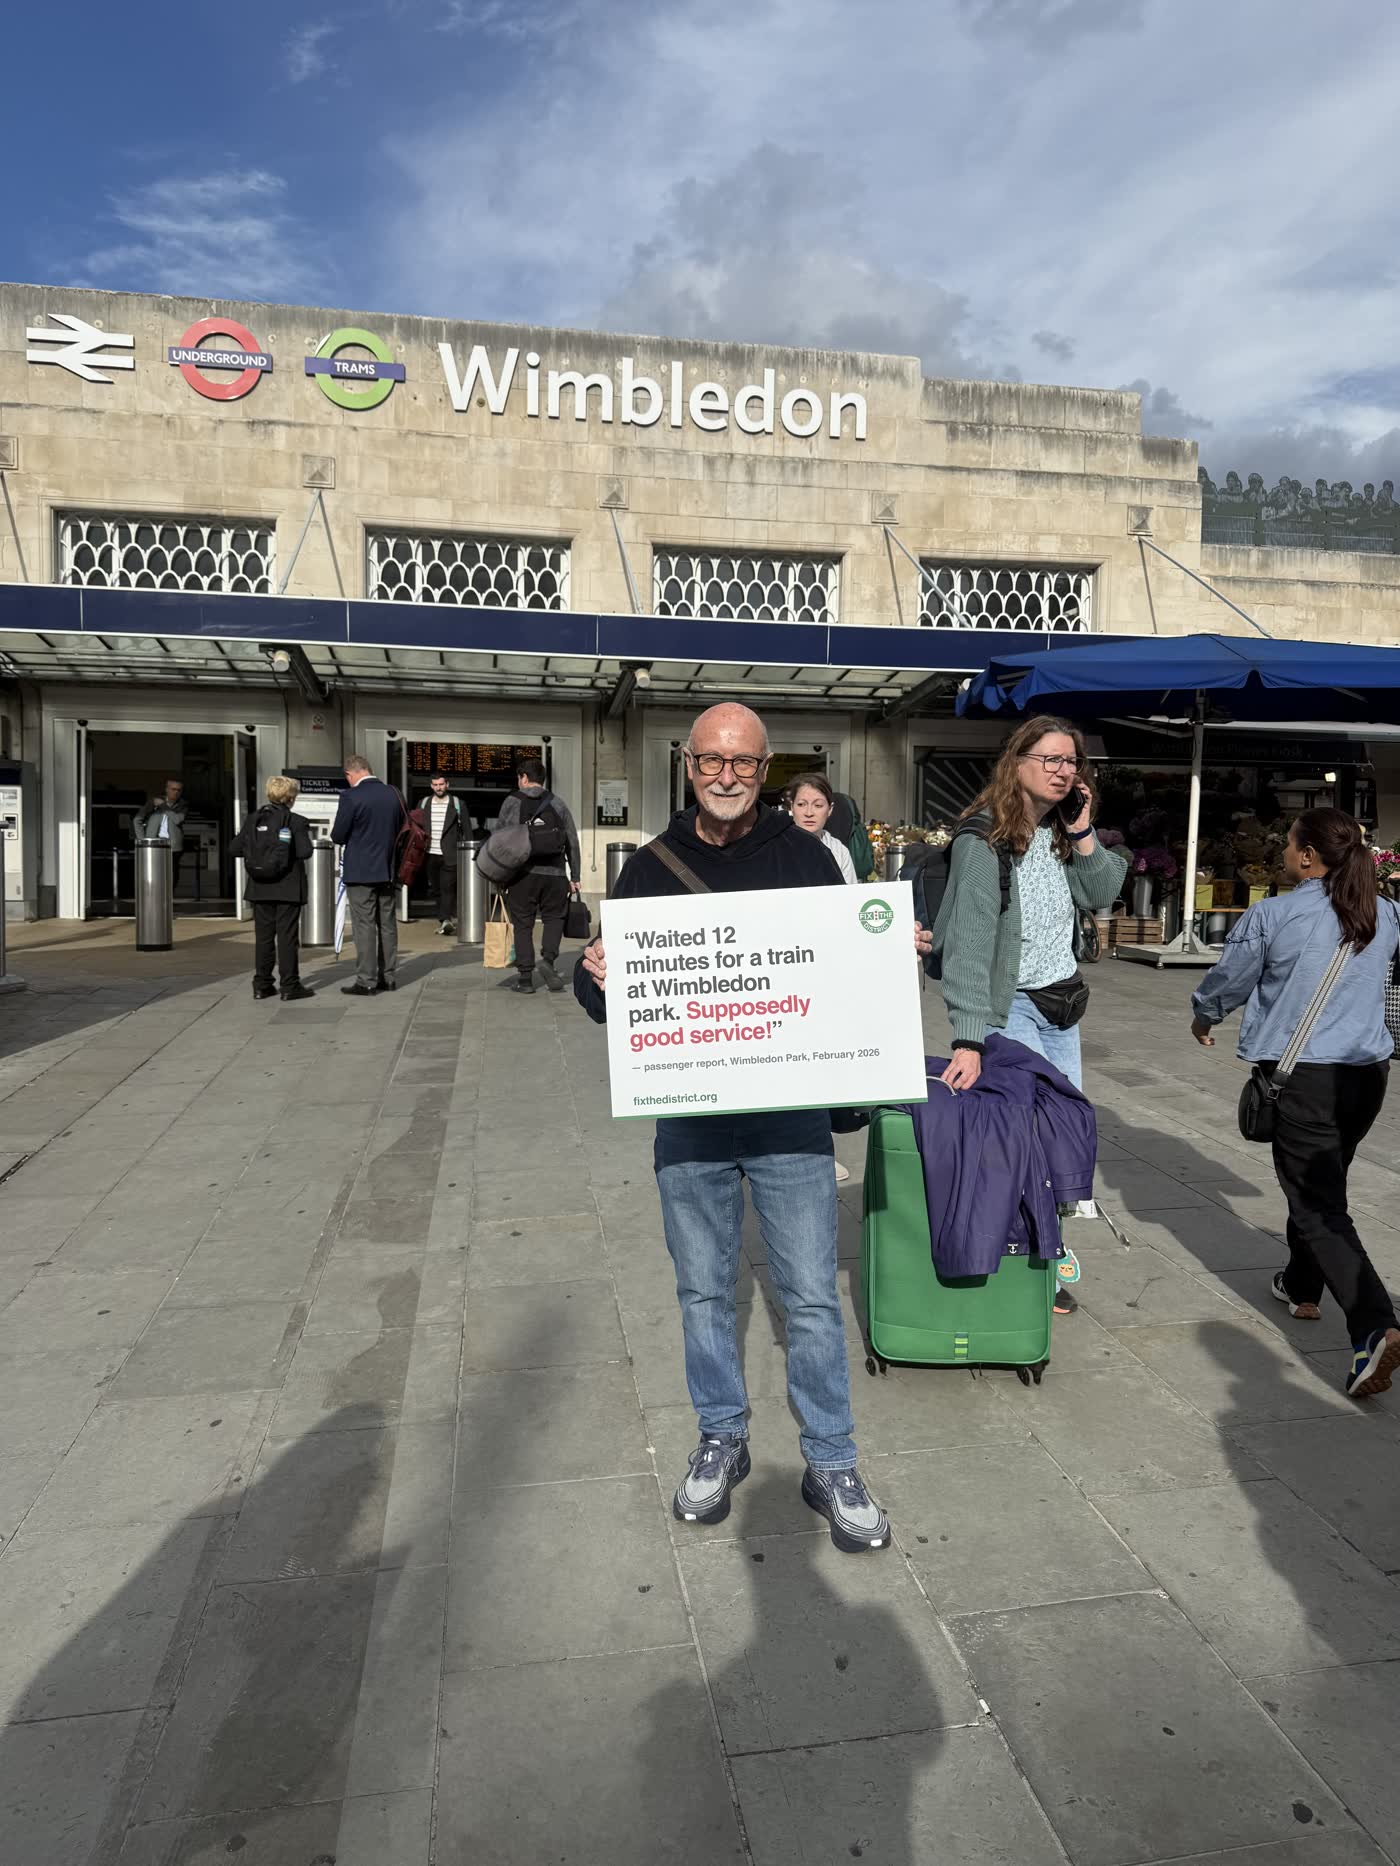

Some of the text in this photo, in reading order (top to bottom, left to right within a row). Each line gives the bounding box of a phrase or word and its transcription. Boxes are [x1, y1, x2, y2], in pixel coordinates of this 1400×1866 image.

[172, 350, 267, 366] UNDERGROUND
[334, 362, 375, 374] TRAMS
[438, 342, 866, 439] Wimbledon
[860, 911, 893, 920] FIX THE
[712, 926, 737, 944] 12
[863, 920, 891, 933] DISTRICT
[626, 945, 815, 975] minutes for a train
[627, 974, 771, 999] at Wimbledon
[629, 994, 811, 1028] park. Supposedly
[630, 1027, 684, 1053] good
[644, 1061, 694, 1073] passenger
[696, 1058, 728, 1069] report,
[729, 1055, 784, 1065] Wimbledon
[786, 1053, 810, 1062] Park,
[813, 1051, 855, 1061] February
[857, 1048, 880, 1057] 2026
[633, 1093, 718, 1106] fixthedistrict.org
